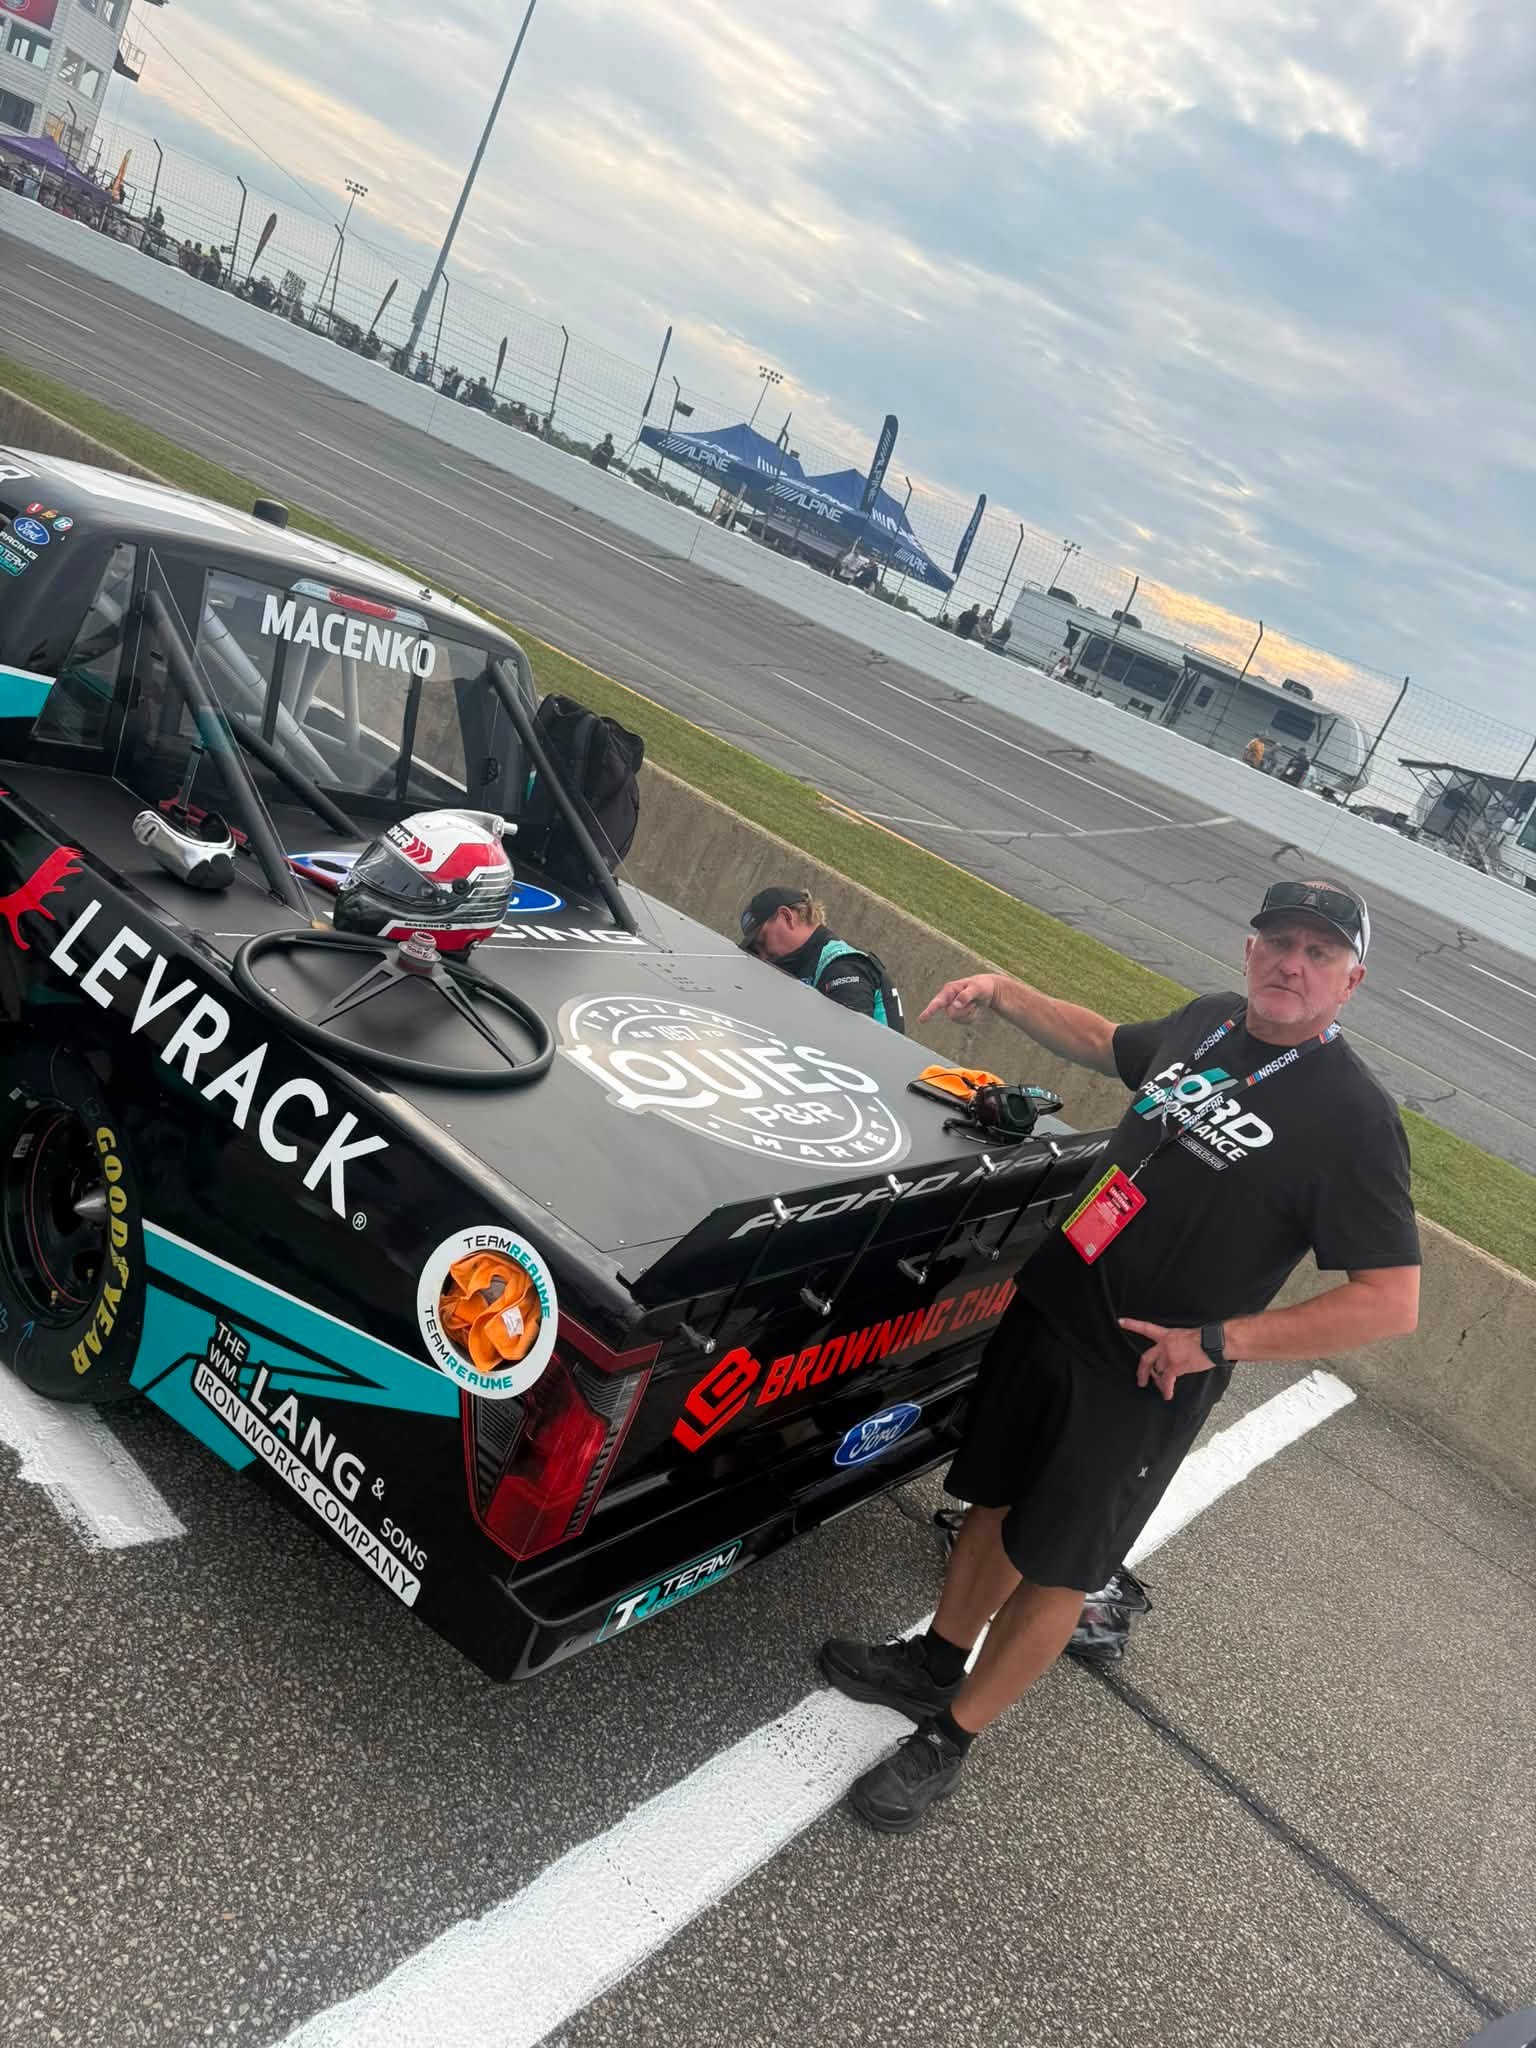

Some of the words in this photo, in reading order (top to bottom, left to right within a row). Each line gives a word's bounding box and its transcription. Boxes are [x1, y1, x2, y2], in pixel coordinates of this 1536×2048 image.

[680, 446, 731, 472] ALPINE
[788, 493, 843, 523] ALPINE
[0, 531, 39, 561] RACING
[2, 549, 26, 569] TEAM
[260, 594, 436, 679] MACENKO
[582, 1003, 735, 1031] ITALIAN
[49, 899, 390, 1219] LEVRACK
[1194, 1028, 1225, 1061] NASCAR
[1258, 1049, 1299, 1080] NASCAR
[740, 1102, 845, 1128] P&R
[1154, 1062, 1274, 1148] FORD
[752, 1120, 889, 1158] MARKET
[729, 1172, 960, 1240] FORD
[70, 1127, 129, 1375] GOODYEAR
[218, 1322, 247, 1362] THE
[755, 1297, 952, 1408] BROWNING
[949, 1278, 1018, 1331] CHA
[210, 1343, 238, 1386] WM.
[849, 1412, 909, 1459] Ford
[199, 1369, 241, 1422] IRON
[245, 1413, 311, 1493] WORKS
[313, 1488, 415, 1595] COMPANY
[250, 1367, 366, 1502] LANG
[371, 1478, 385, 1500] &
[380, 1518, 428, 1571] SONS
[664, 1547, 737, 1597] TEAM
